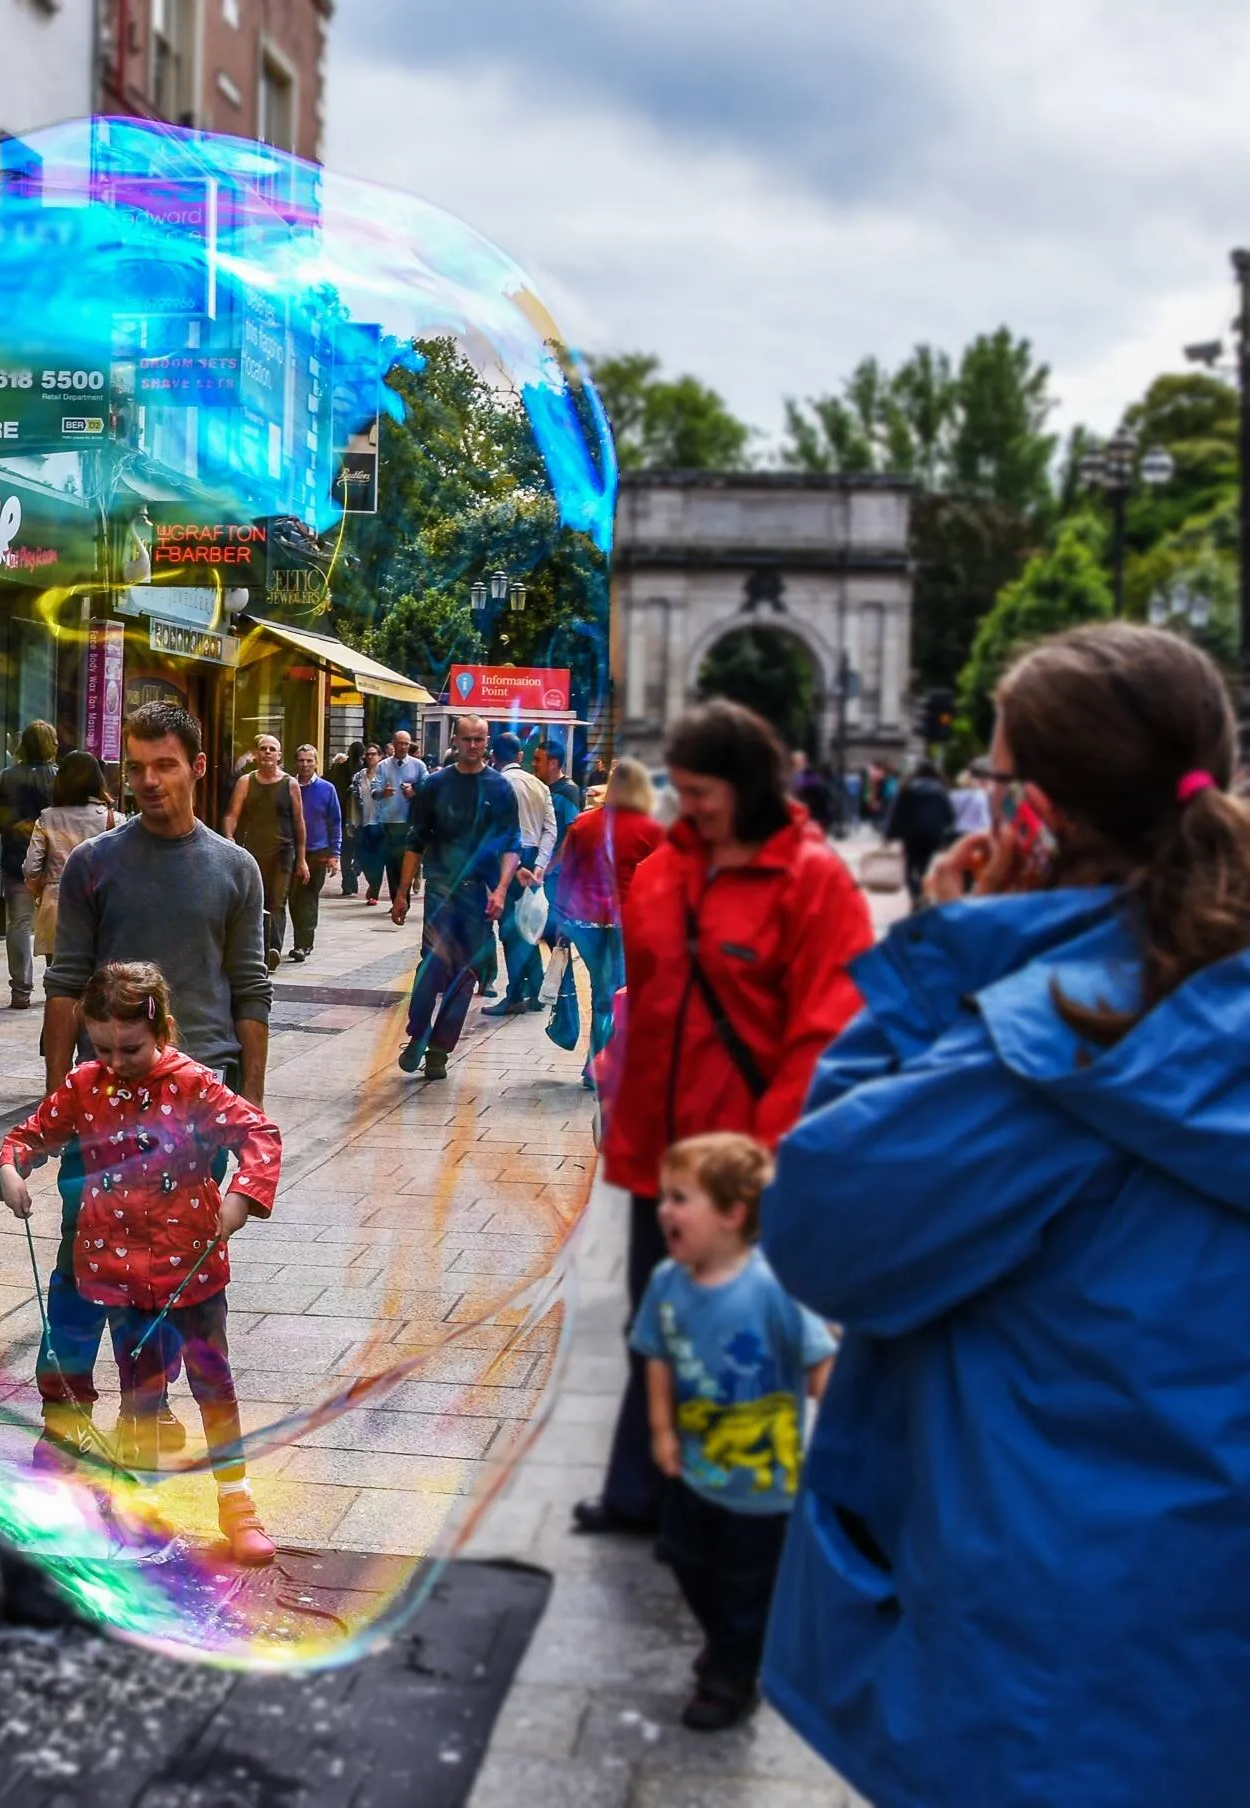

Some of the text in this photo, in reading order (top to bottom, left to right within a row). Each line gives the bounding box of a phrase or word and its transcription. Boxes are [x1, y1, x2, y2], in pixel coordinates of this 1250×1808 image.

[15, 221, 74, 246] LET
[41, 370, 104, 389] 5500
[65, 421, 84, 429] BER
[170, 524, 267, 542] GRAFTON
[170, 546, 252, 563] BARBER
[89, 630, 98, 649] Face
[88, 653, 98, 672] Body
[481, 675, 542, 687] Information
[481, 686, 508, 696] Point
